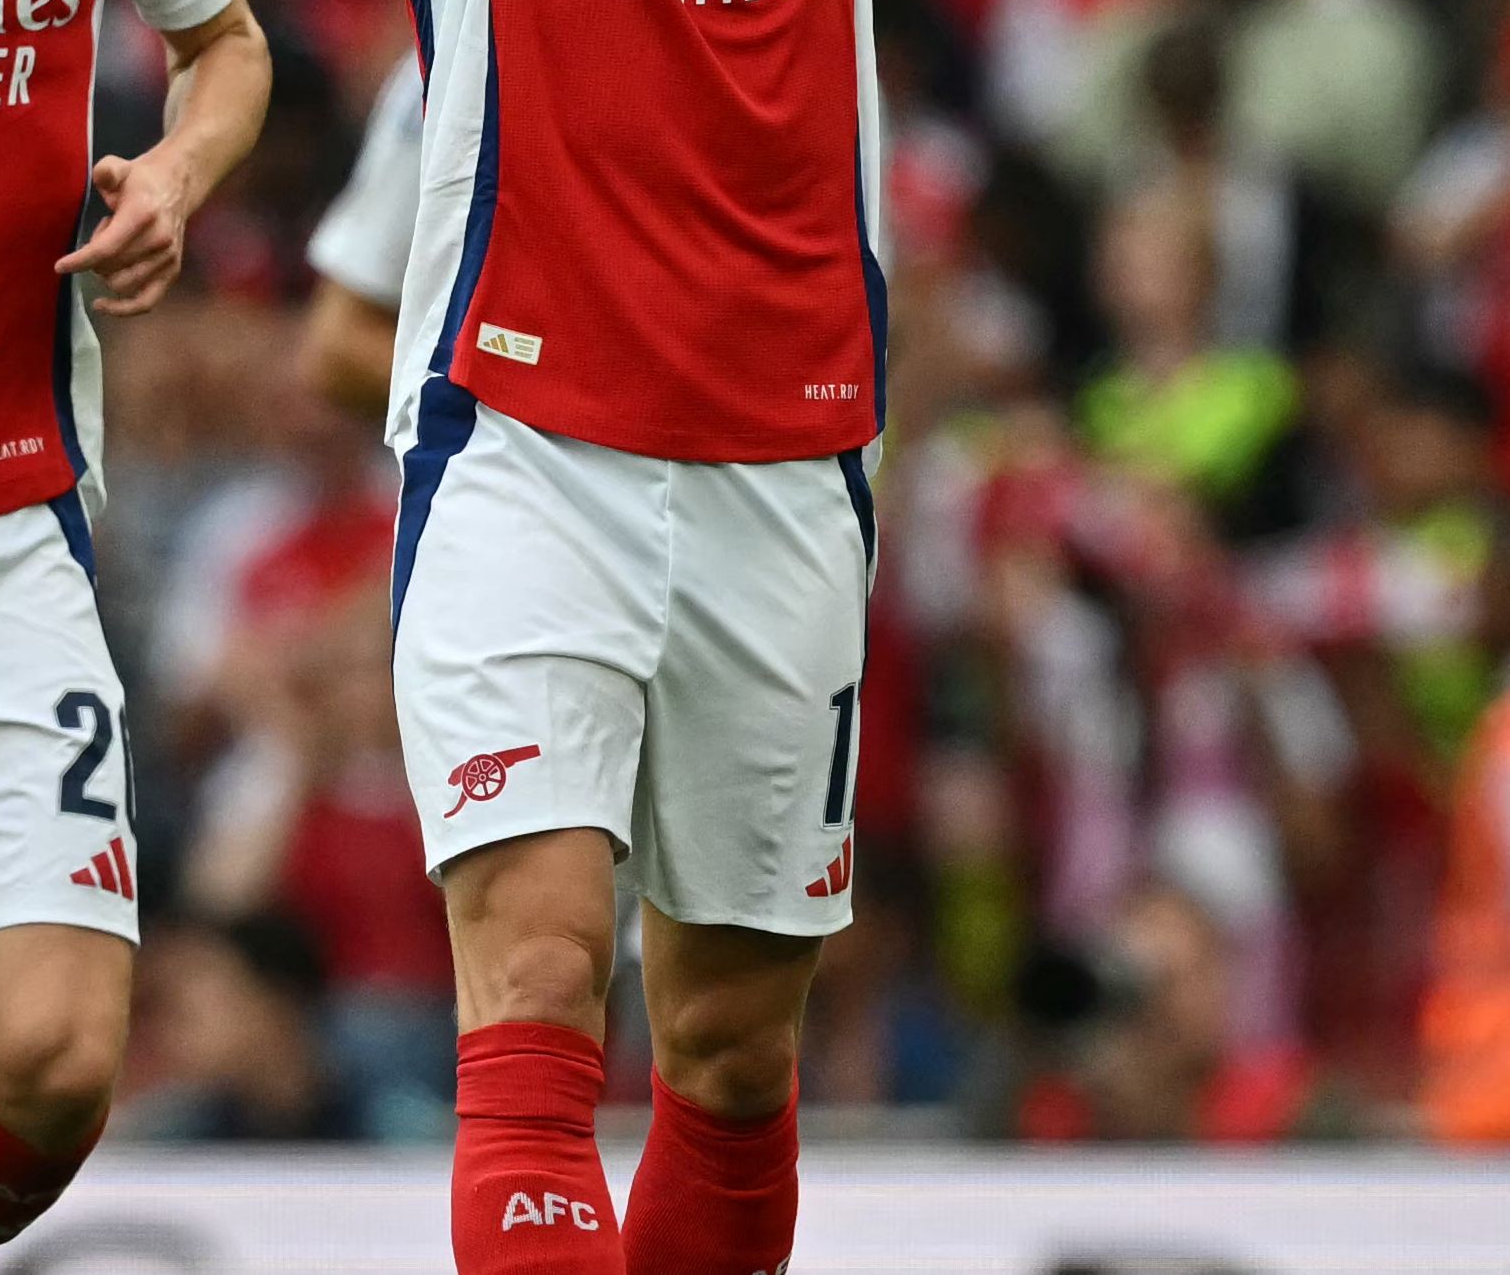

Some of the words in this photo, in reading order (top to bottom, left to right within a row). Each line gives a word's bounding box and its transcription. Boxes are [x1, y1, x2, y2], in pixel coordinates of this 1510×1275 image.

[804, 383, 860, 400] HEAT.RDY
[53, 687, 138, 834] 2
[822, 680, 861, 829] 1
[502, 1191, 599, 1232] AFC
